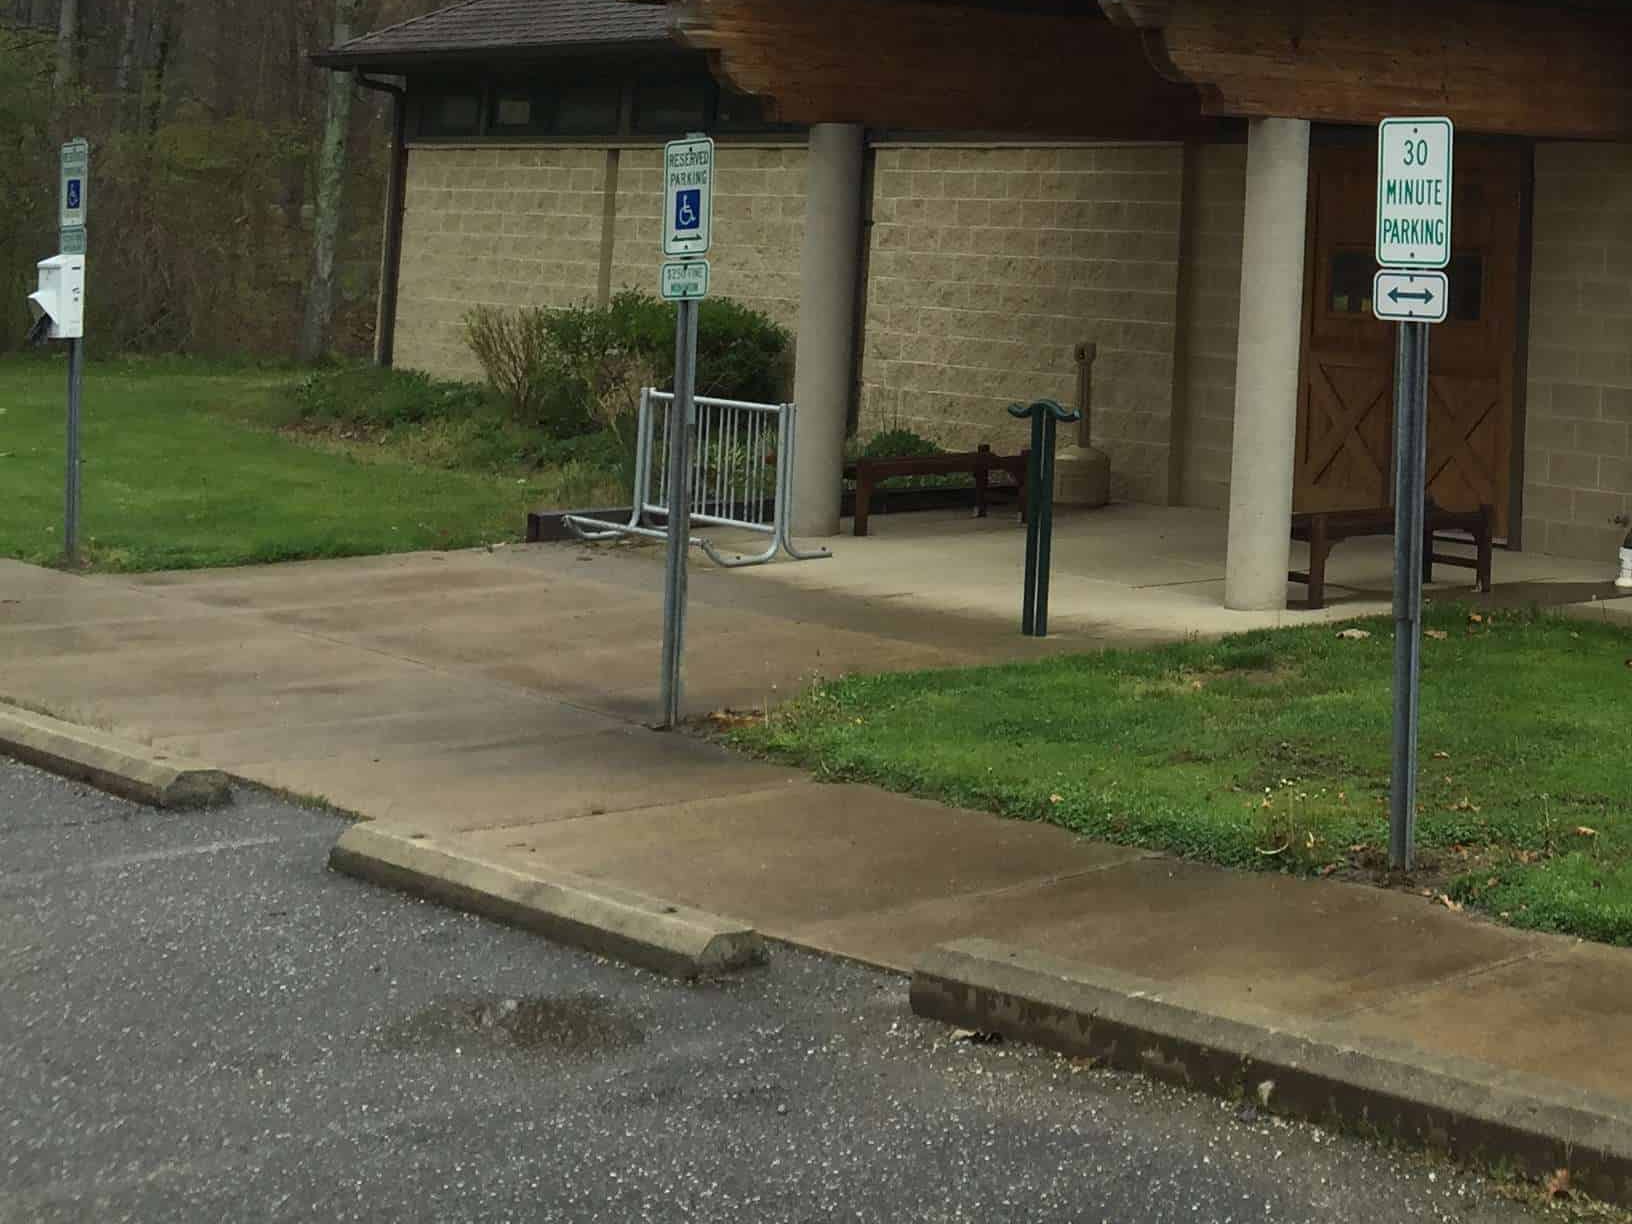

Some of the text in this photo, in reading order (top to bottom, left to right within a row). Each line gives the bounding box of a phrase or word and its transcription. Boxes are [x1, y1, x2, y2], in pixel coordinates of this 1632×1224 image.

[669, 151, 709, 168] RESERVED
[1403, 139, 1428, 166] 30
[670, 170, 707, 185] PARKING
[1386, 179, 1442, 206] MINUTE
[1383, 218, 1444, 246] PARKING
